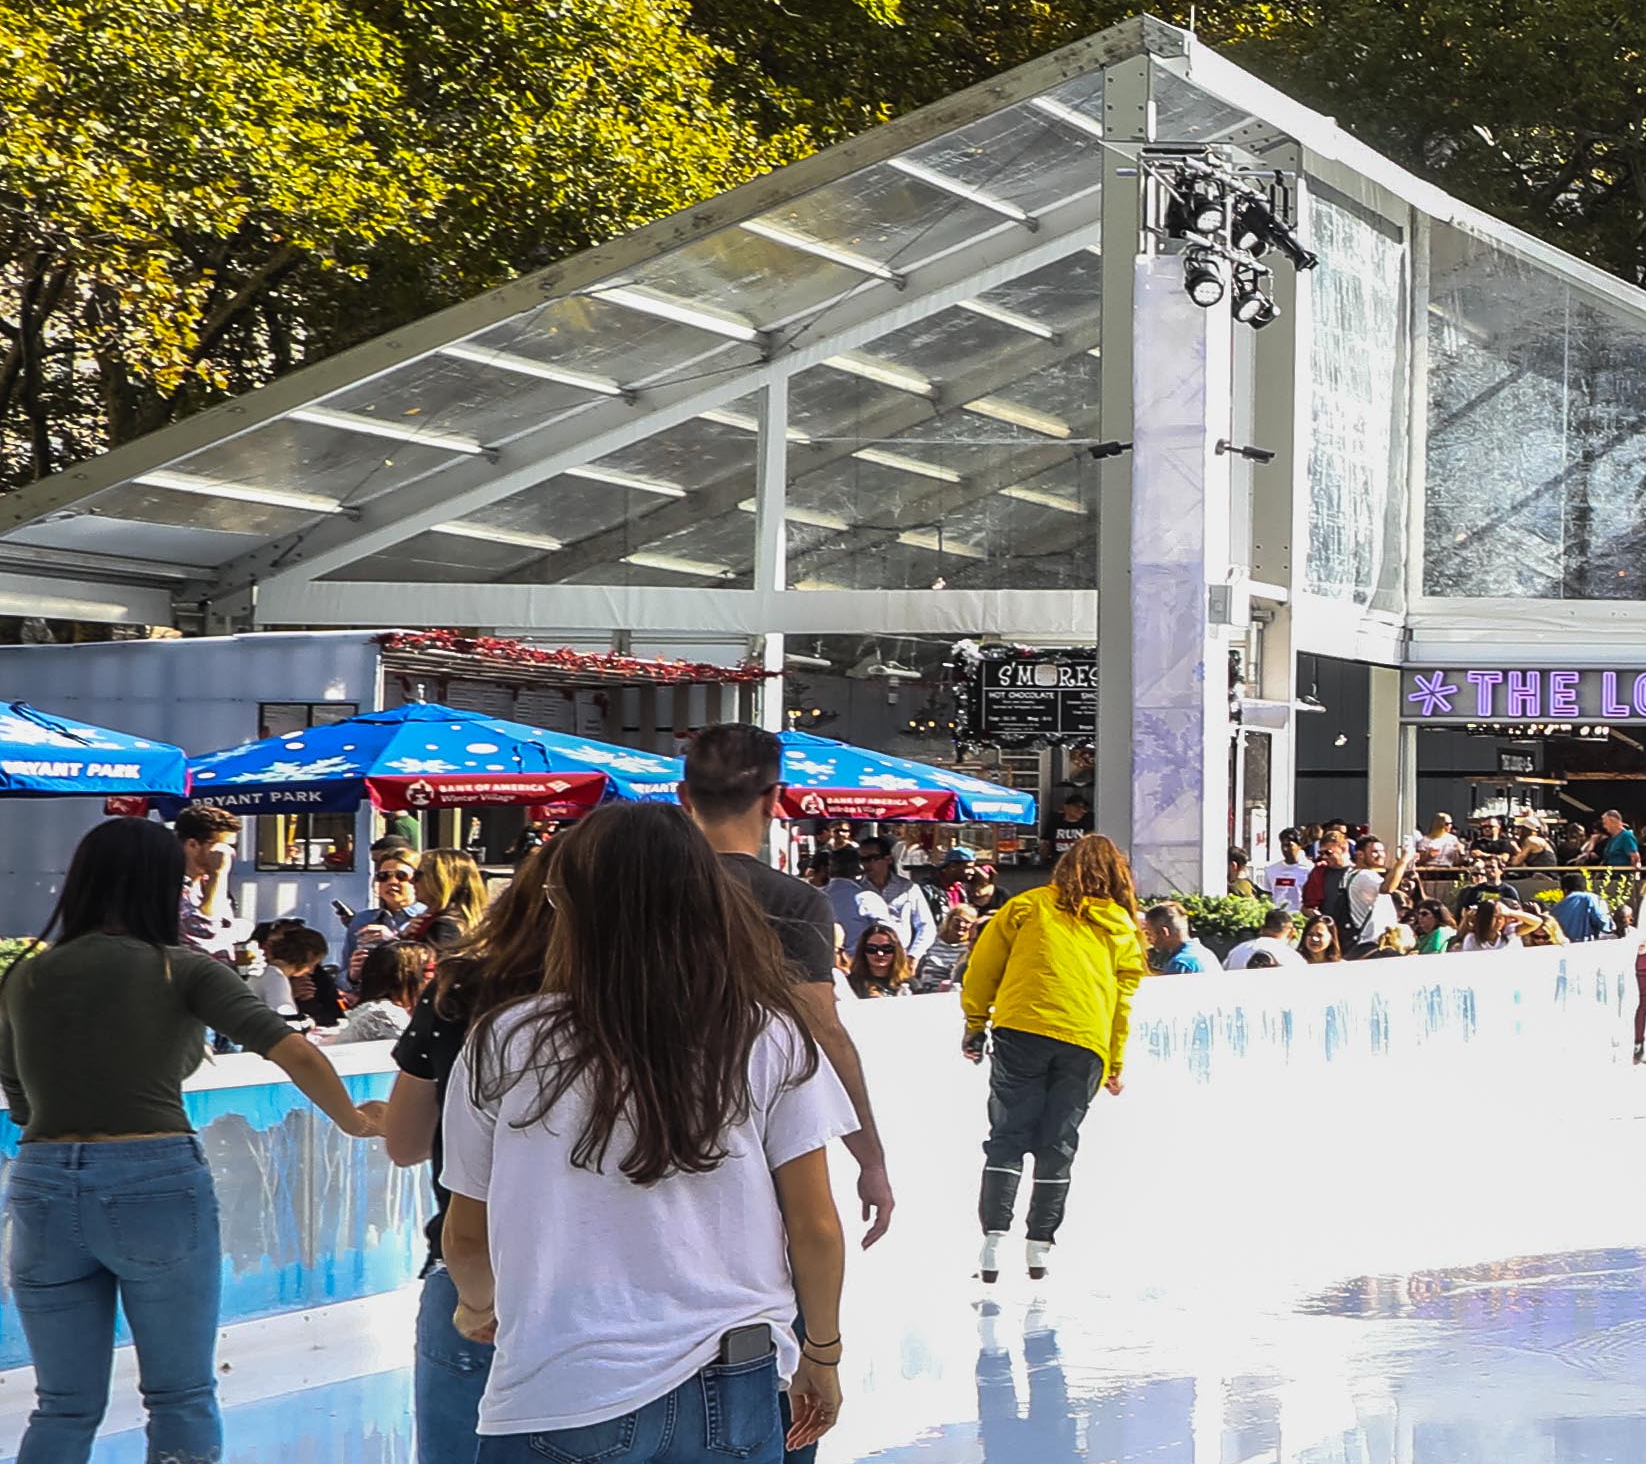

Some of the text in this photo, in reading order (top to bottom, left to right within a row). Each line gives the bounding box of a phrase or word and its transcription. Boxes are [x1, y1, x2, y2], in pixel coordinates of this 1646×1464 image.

[1466, 670, 1580, 718] THE
[1, 760, 140, 778] BRYANT PARK
[492, 783, 546, 792] AMERICA
[271, 791, 323, 804] PARK
[440, 793, 478, 803] Winter
[1056, 828, 1084, 840] RUN
